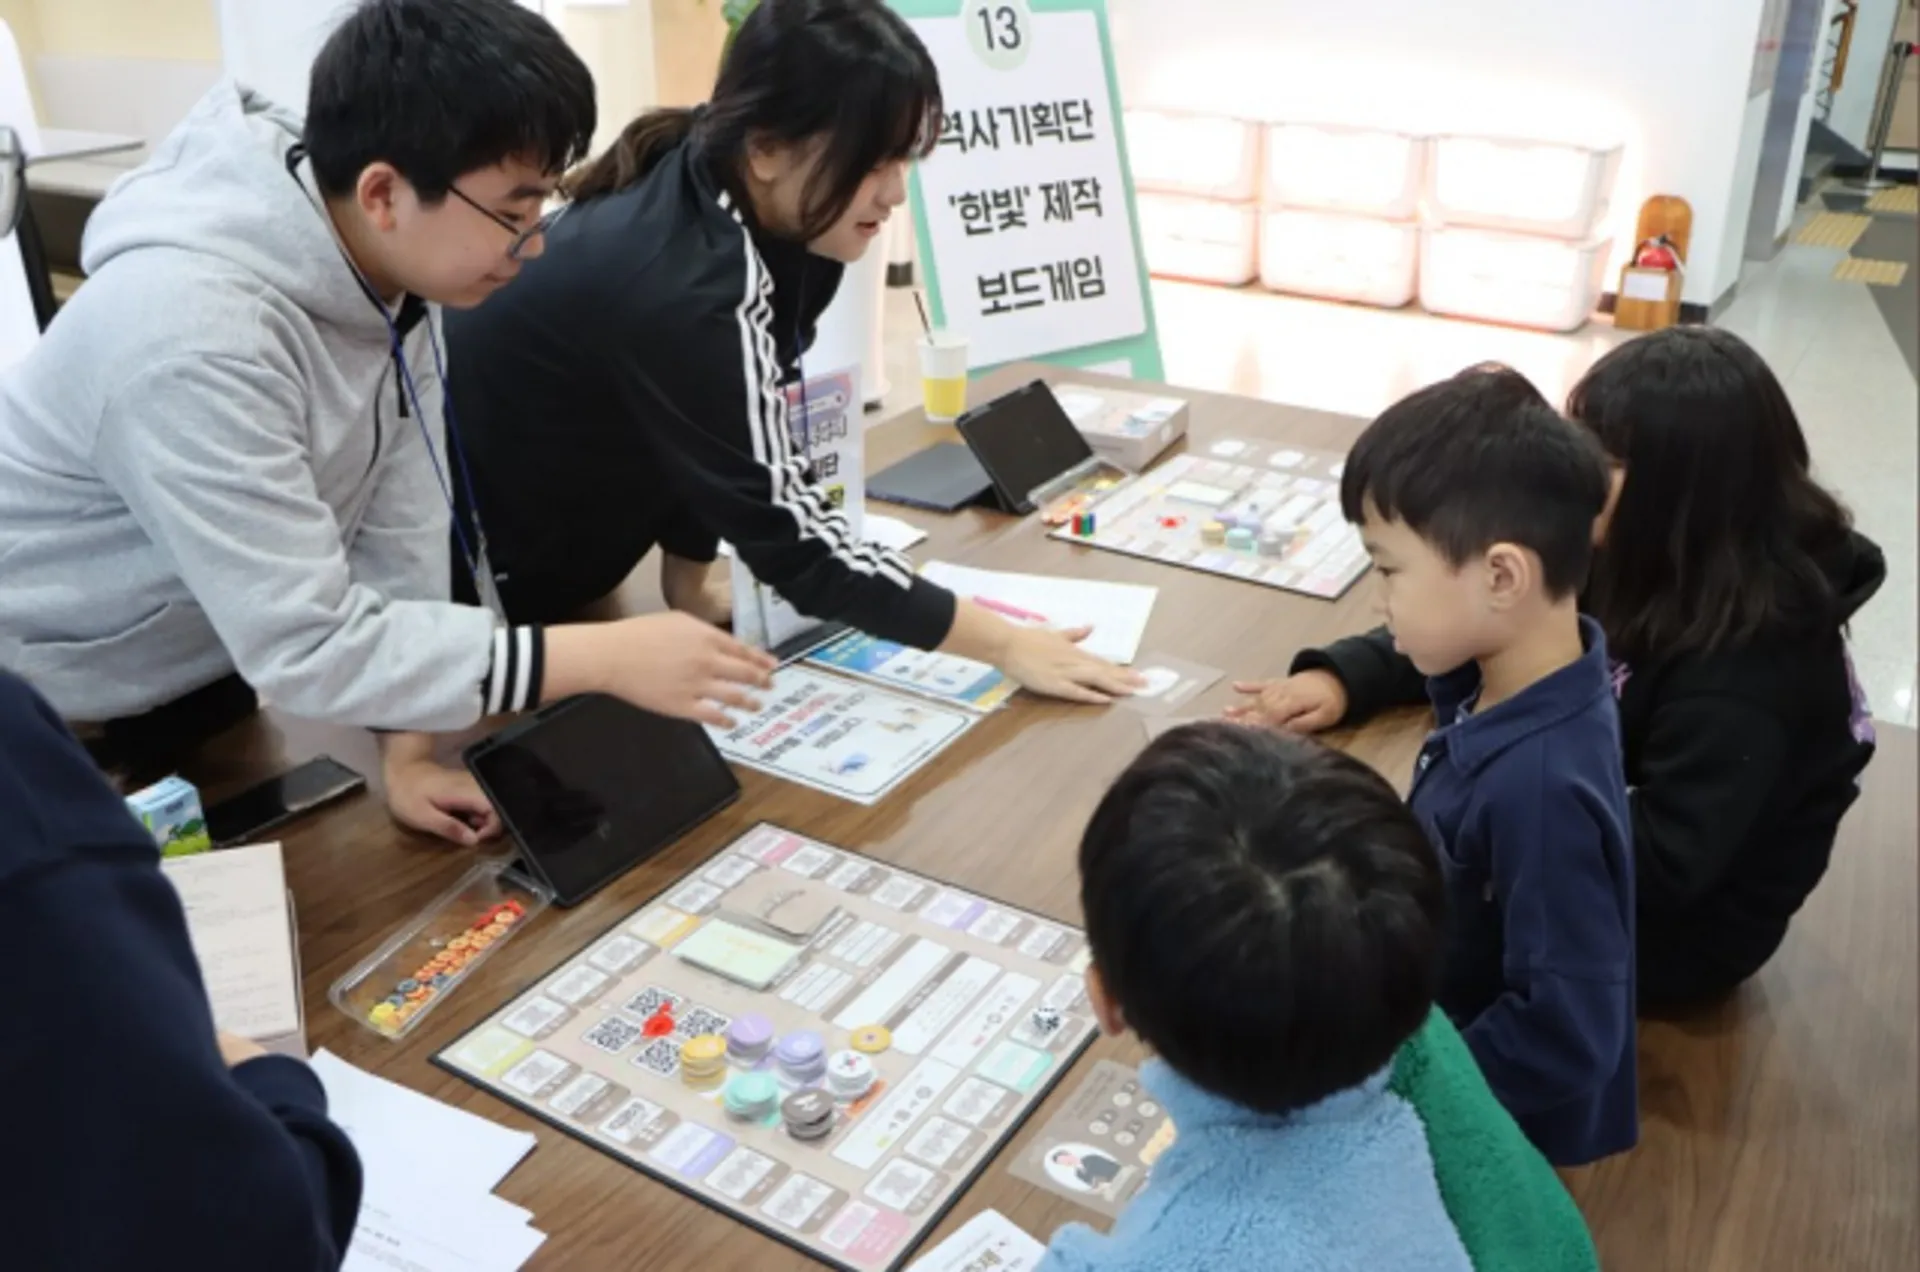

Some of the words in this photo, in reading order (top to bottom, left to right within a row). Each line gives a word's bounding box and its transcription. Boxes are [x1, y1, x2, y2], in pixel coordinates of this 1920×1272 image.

[978, 7, 1021, 51] 13
[938, 99, 1095, 154] 역사기획단
[949, 186, 1031, 237] '한빛'
[1039, 177, 1103, 224] 제작
[978, 256, 1106, 316] 보드게임
